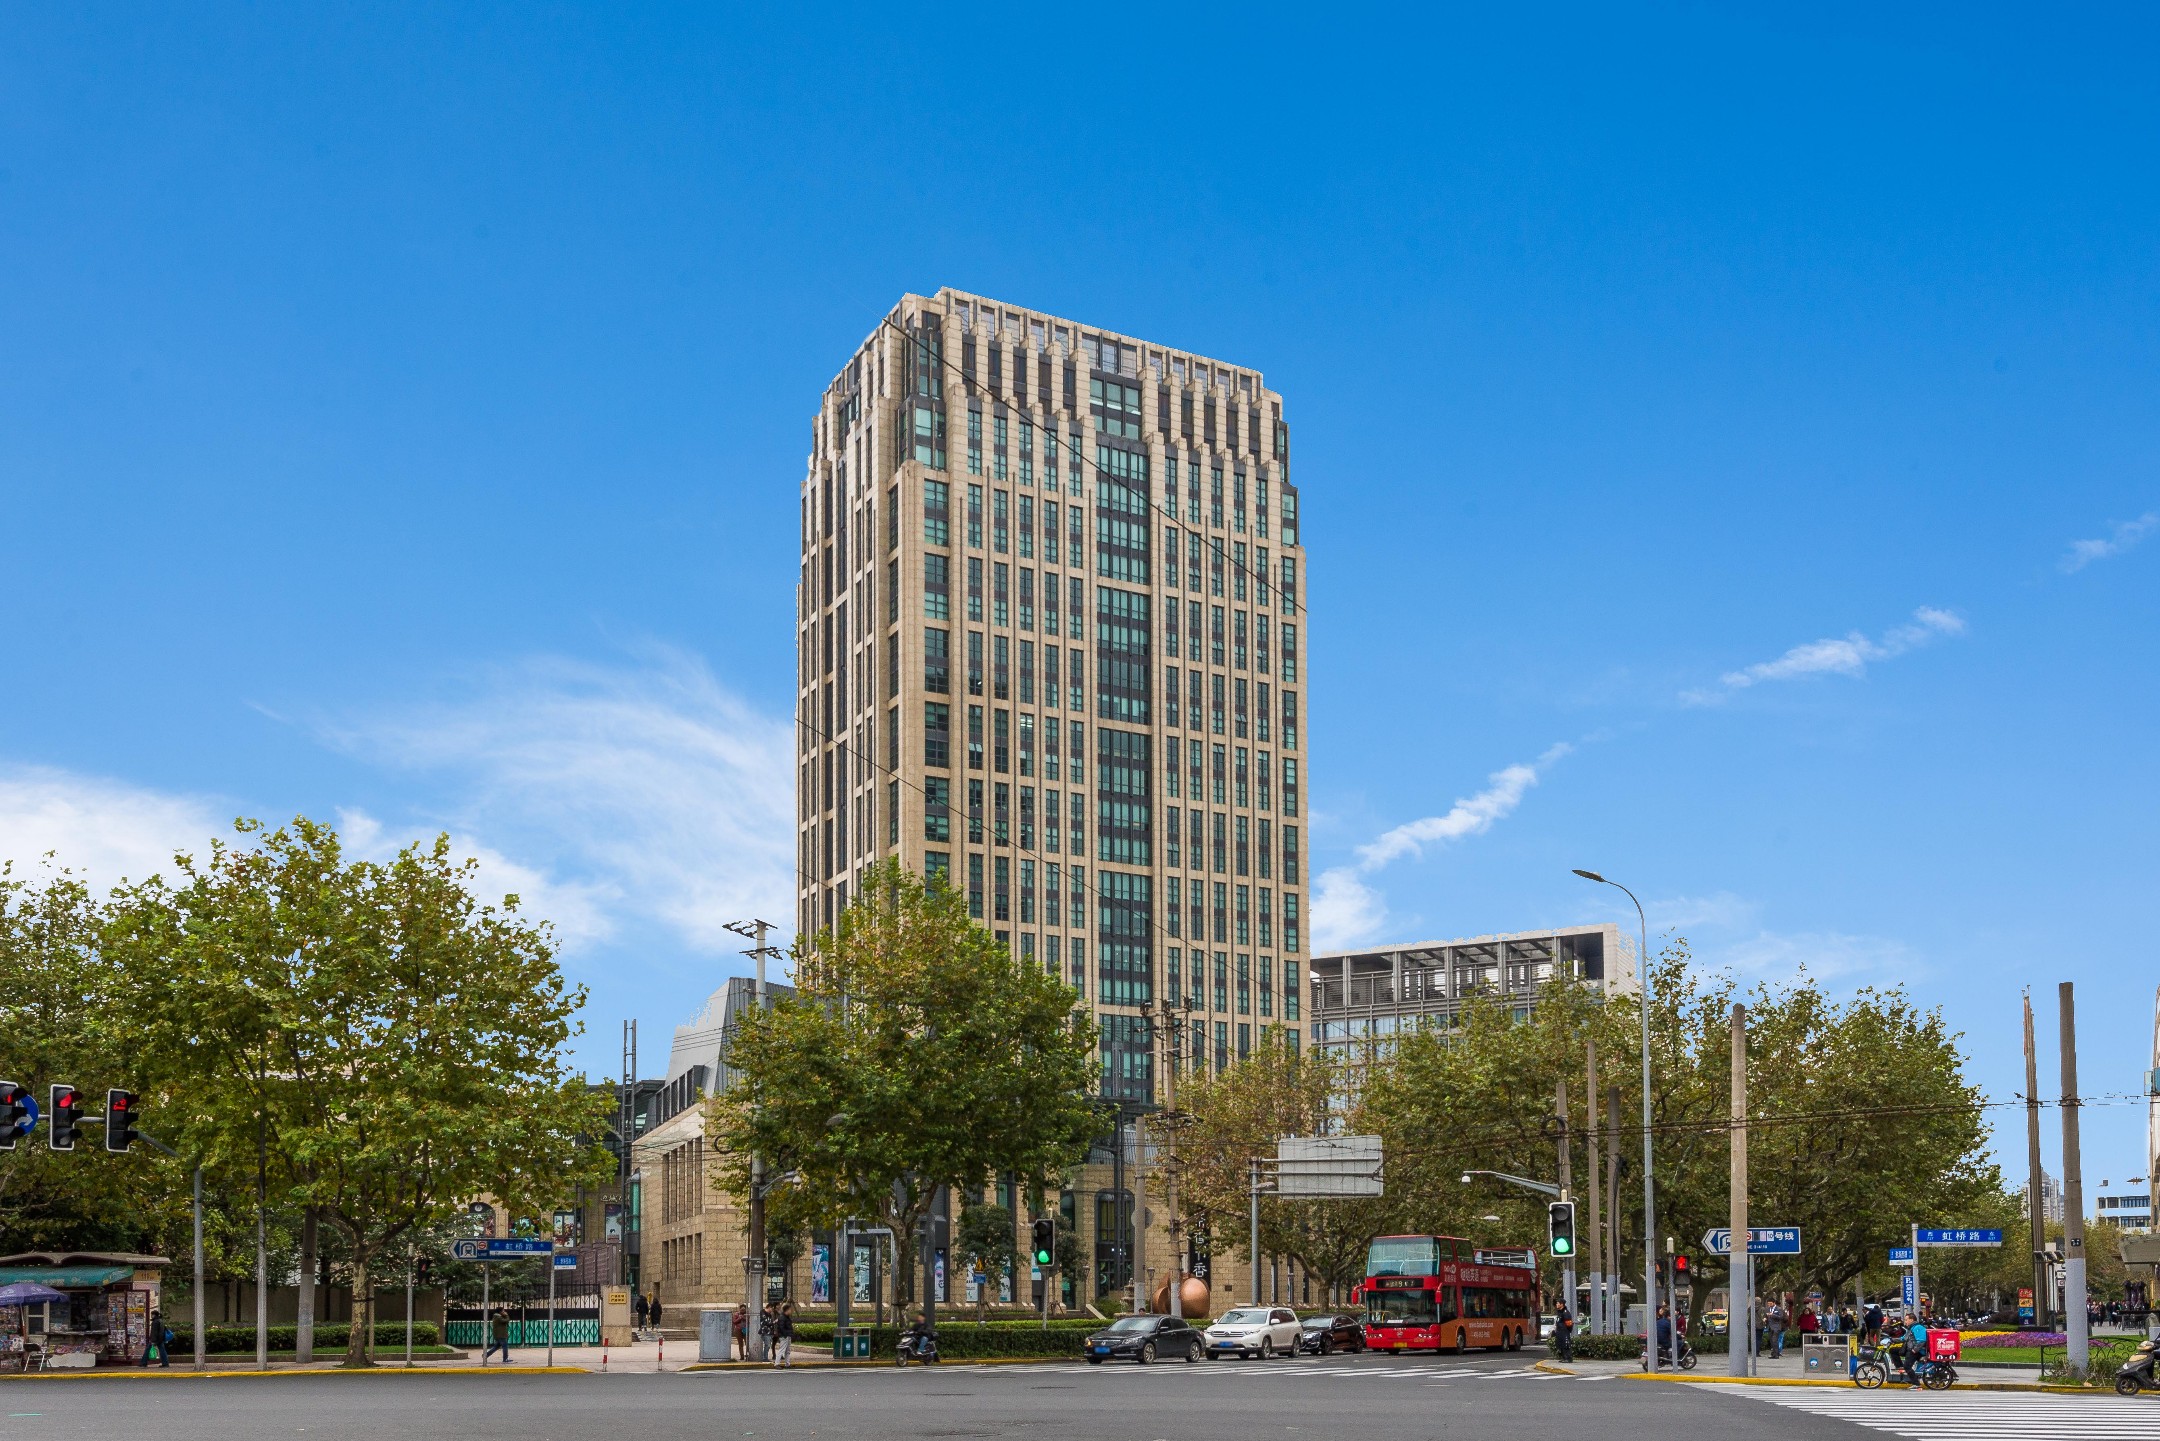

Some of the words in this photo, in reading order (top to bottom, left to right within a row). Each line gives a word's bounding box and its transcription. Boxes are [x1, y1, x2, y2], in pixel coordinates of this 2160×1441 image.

[1775, 1231, 1794, 1241] 号线
[1942, 1231, 1980, 1241] 虹桥路
[505, 1242, 534, 1251] 虹桥路
